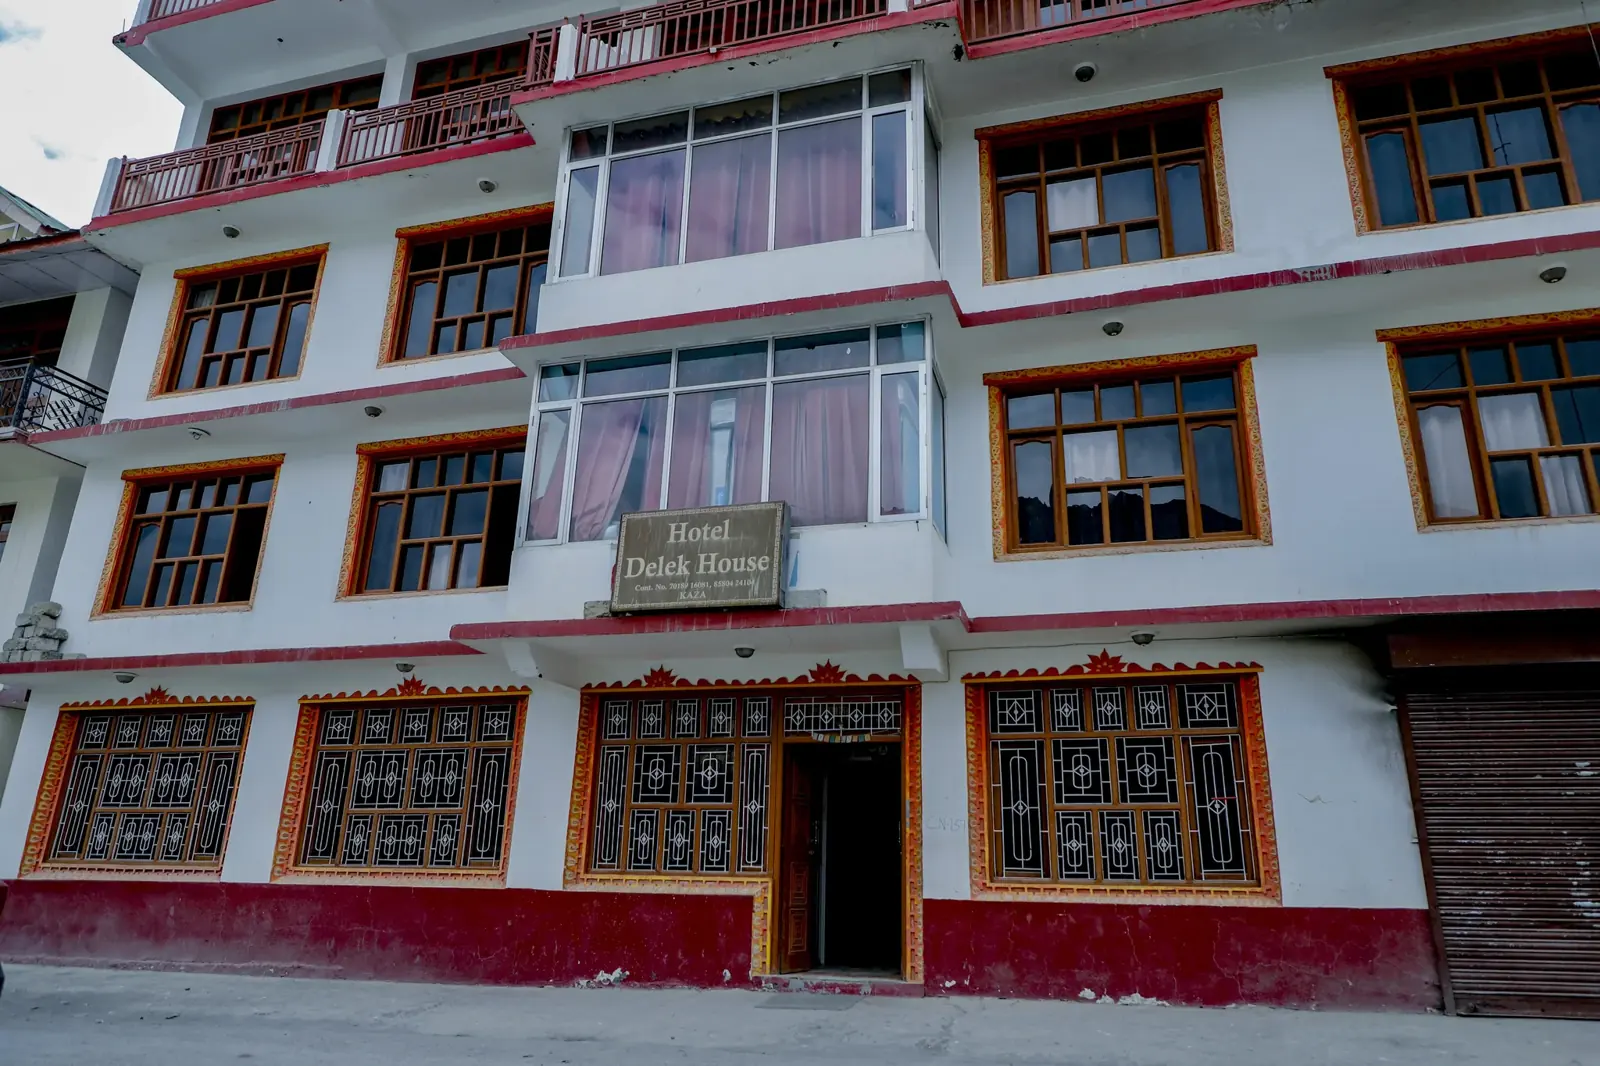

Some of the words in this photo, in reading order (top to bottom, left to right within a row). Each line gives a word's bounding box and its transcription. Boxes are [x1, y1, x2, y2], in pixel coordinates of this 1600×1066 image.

[666, 518, 730, 543] Hotel
[624, 555, 690, 579] Delek
[695, 552, 770, 575] House
[655, 583, 667, 591] No.
[680, 591, 706, 600] KAZA
